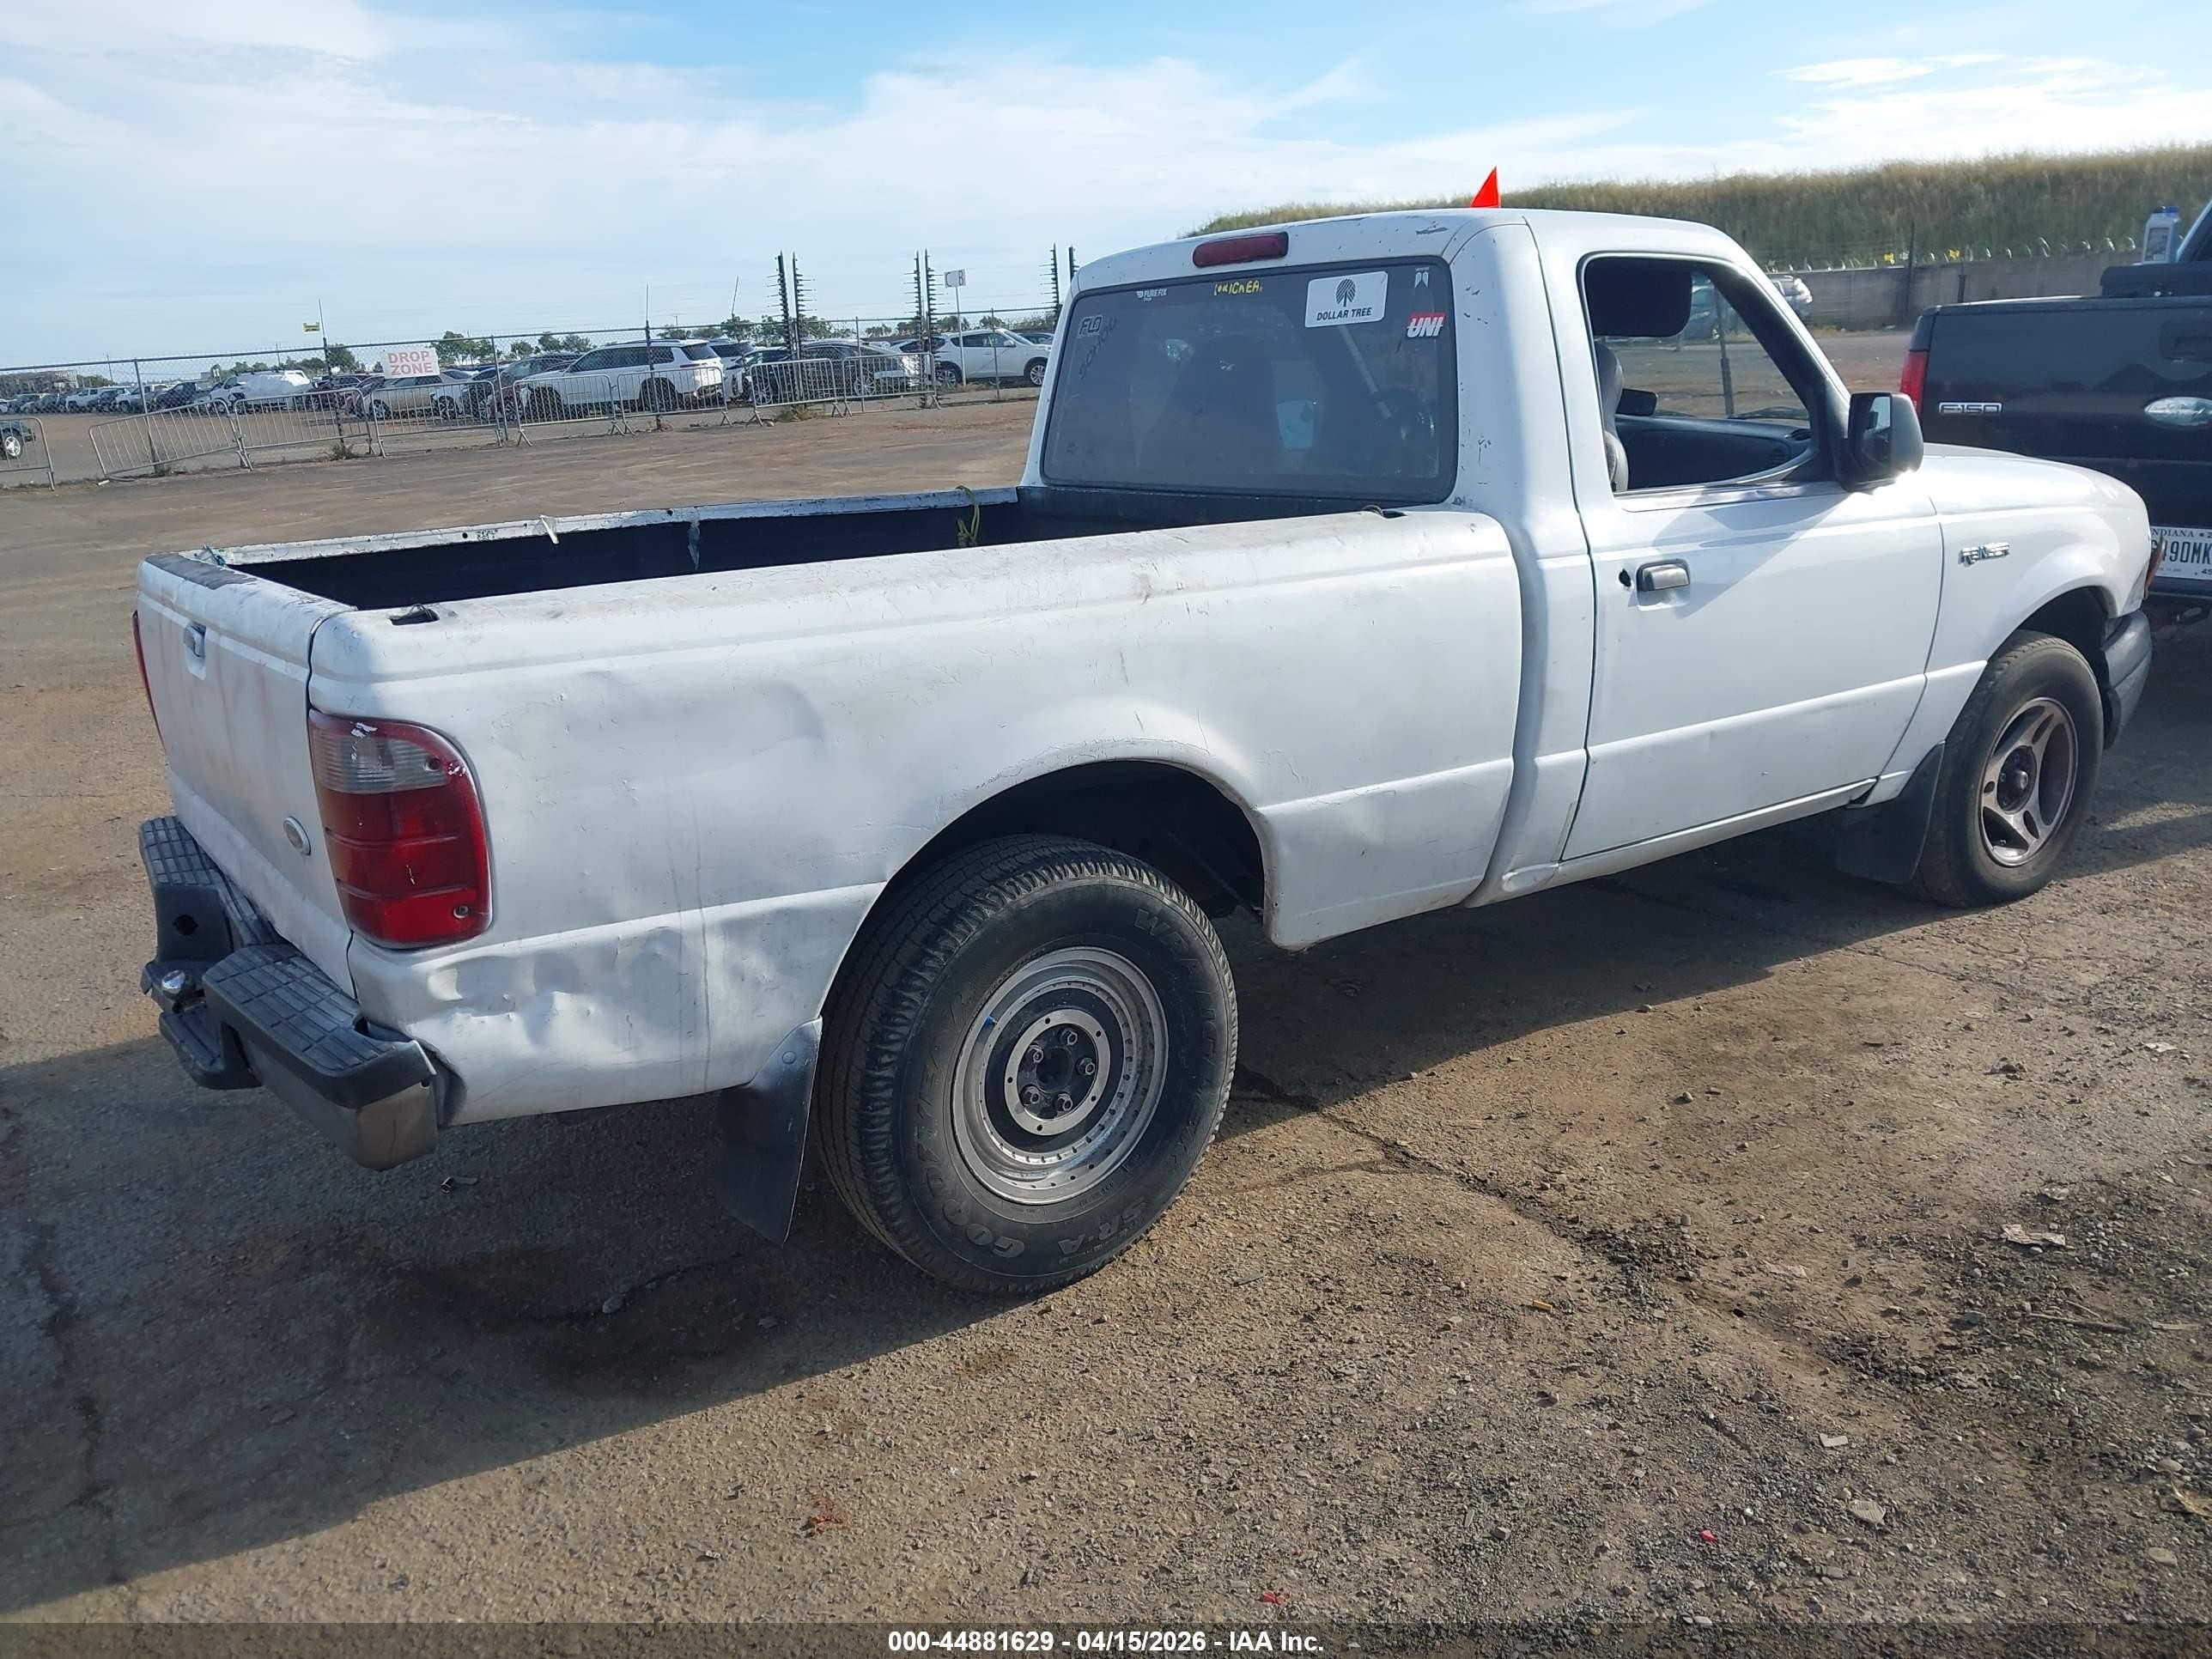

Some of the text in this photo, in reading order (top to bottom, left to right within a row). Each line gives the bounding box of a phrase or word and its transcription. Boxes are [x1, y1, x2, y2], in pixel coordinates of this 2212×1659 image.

[1316, 307, 1373, 321] DOLLAR TREE
[1407, 316, 1444, 338] UNI
[387, 350, 429, 364] DROP
[390, 362, 434, 376] ZONE
[2150, 528, 2195, 538] NDIANA
